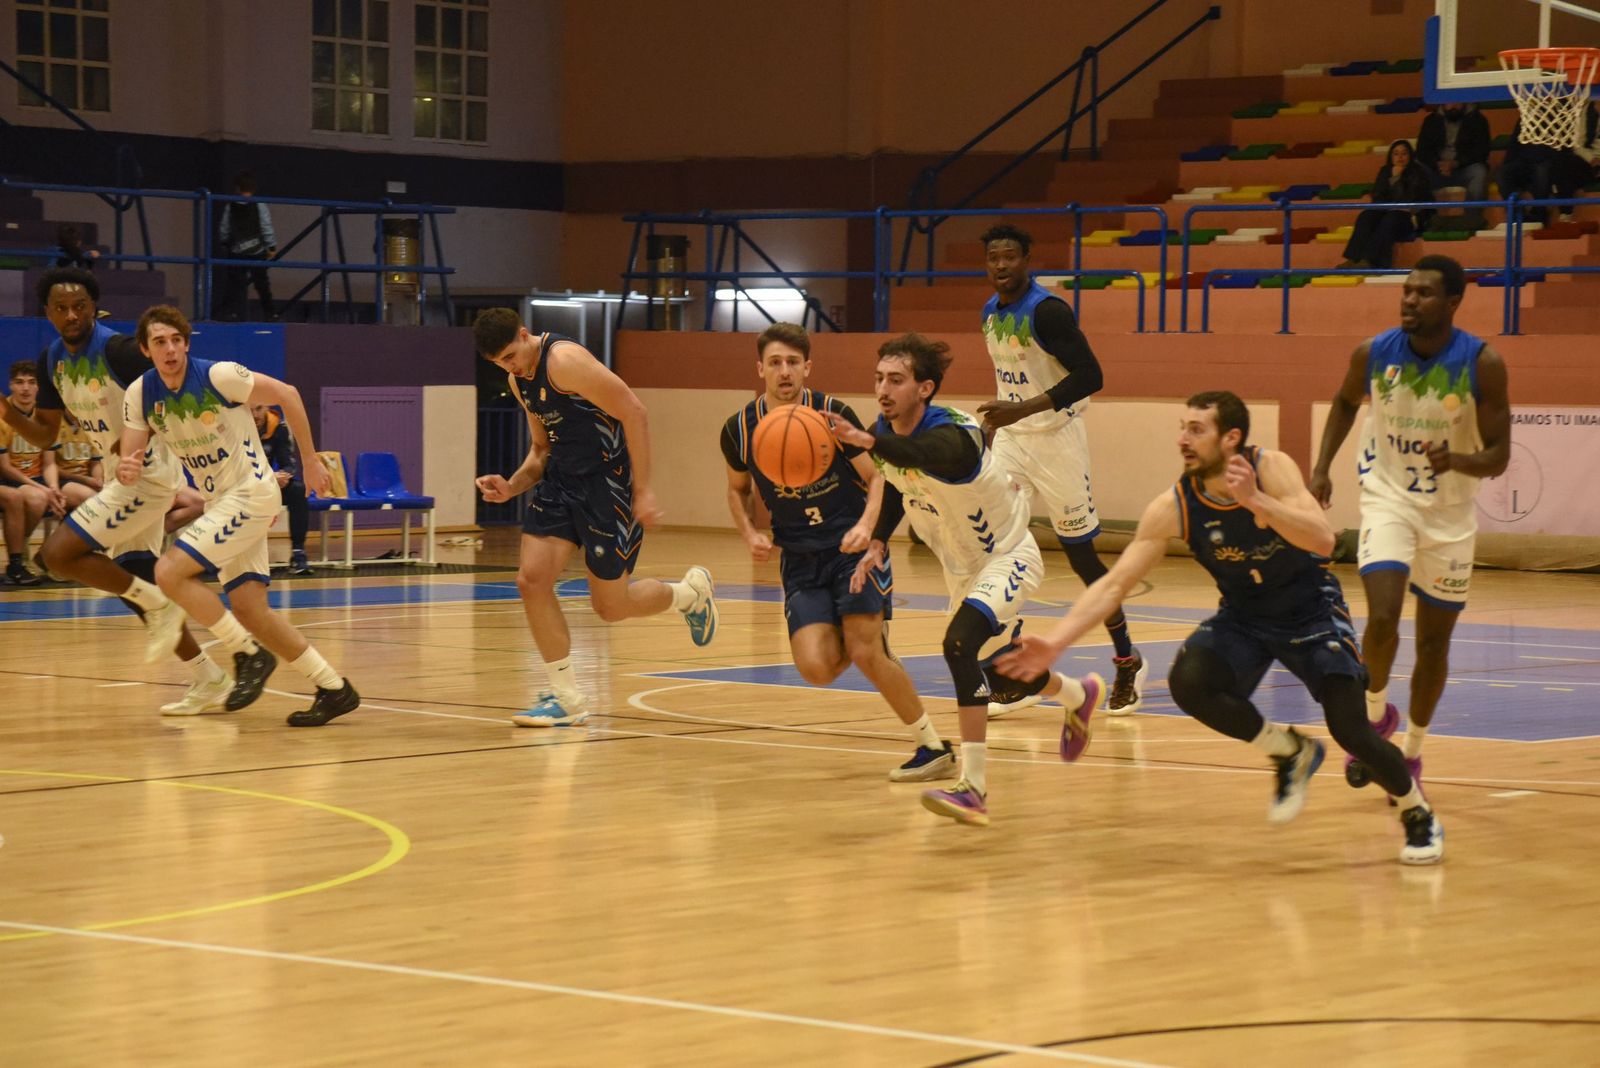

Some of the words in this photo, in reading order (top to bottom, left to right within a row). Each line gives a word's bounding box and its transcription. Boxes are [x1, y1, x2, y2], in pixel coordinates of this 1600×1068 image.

[1554, 414, 1572, 426] TU
[1574, 414, 1600, 426] IMA
[1406, 466, 1438, 493] 23
[804, 506, 824, 526] 3
[1249, 568, 1264, 584] 1
[1442, 578, 1469, 588] case
